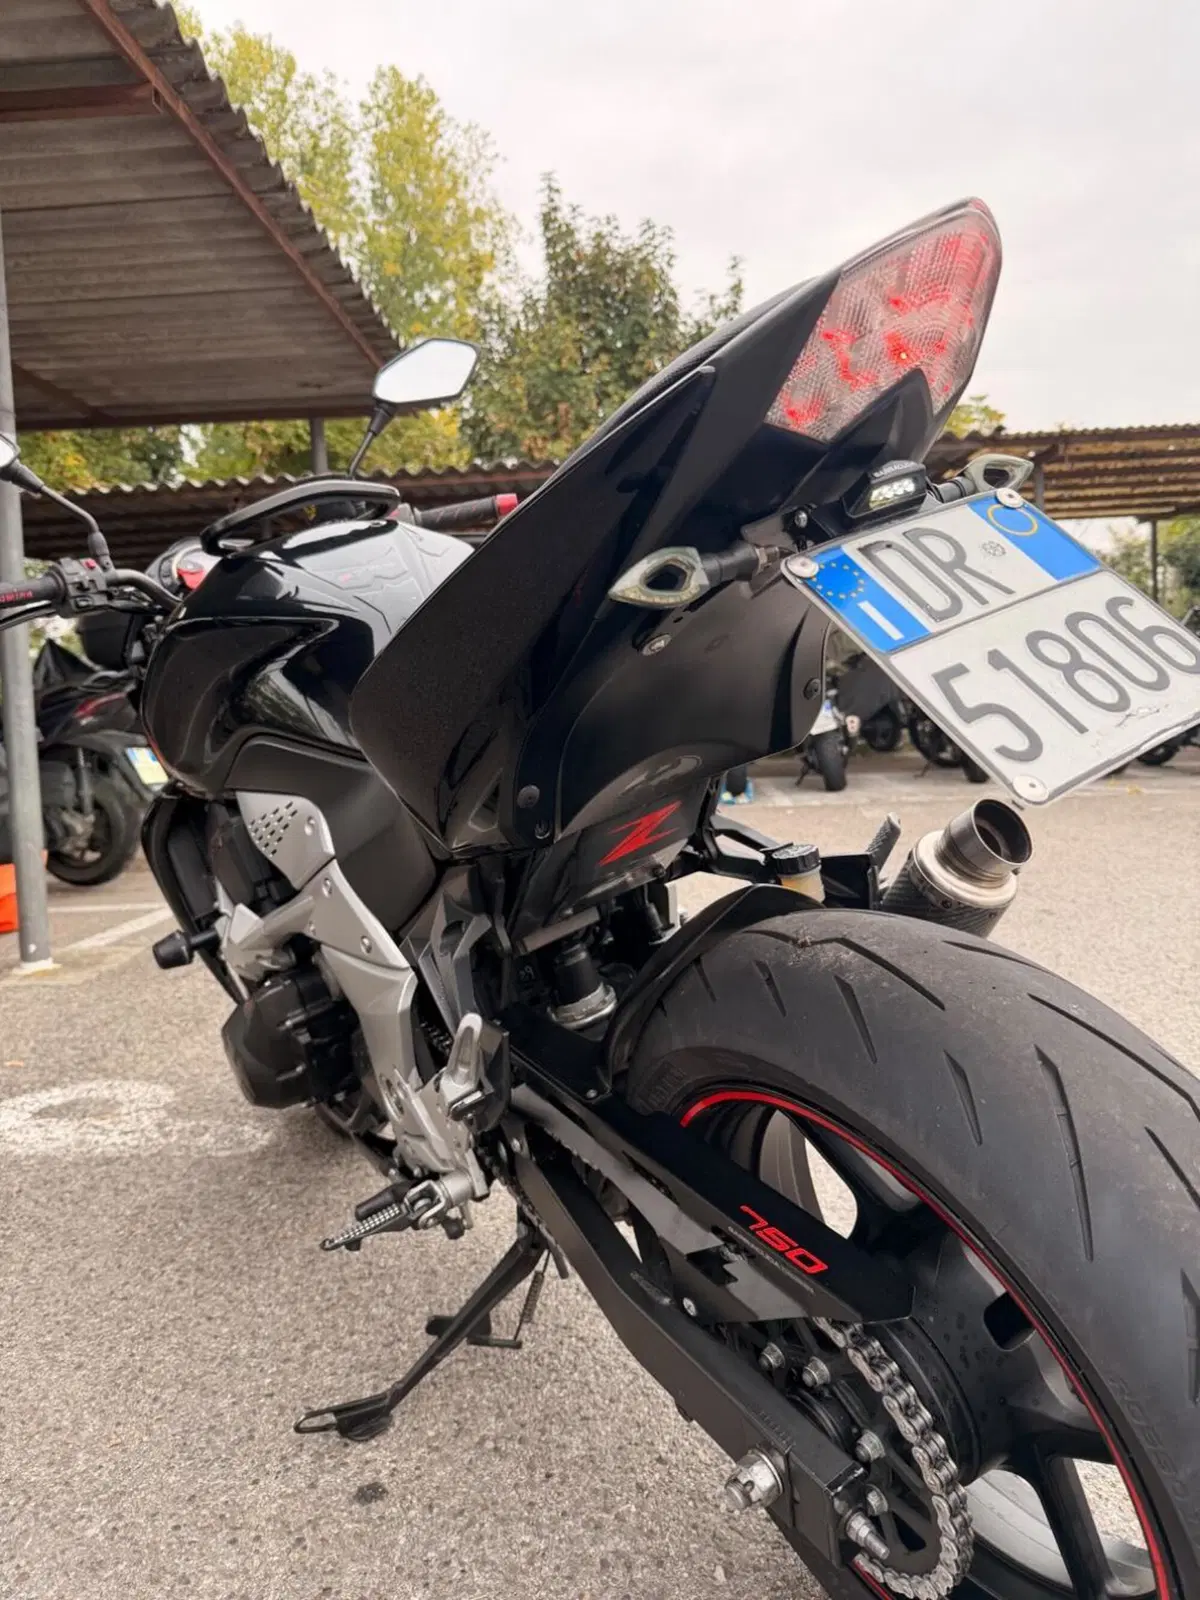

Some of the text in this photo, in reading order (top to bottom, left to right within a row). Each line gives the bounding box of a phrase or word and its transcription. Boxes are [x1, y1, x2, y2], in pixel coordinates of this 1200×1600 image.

[858, 527, 1016, 623] DR
[858, 600, 904, 640] I
[931, 596, 1200, 763] 51806
[740, 1204, 829, 1274] 750
